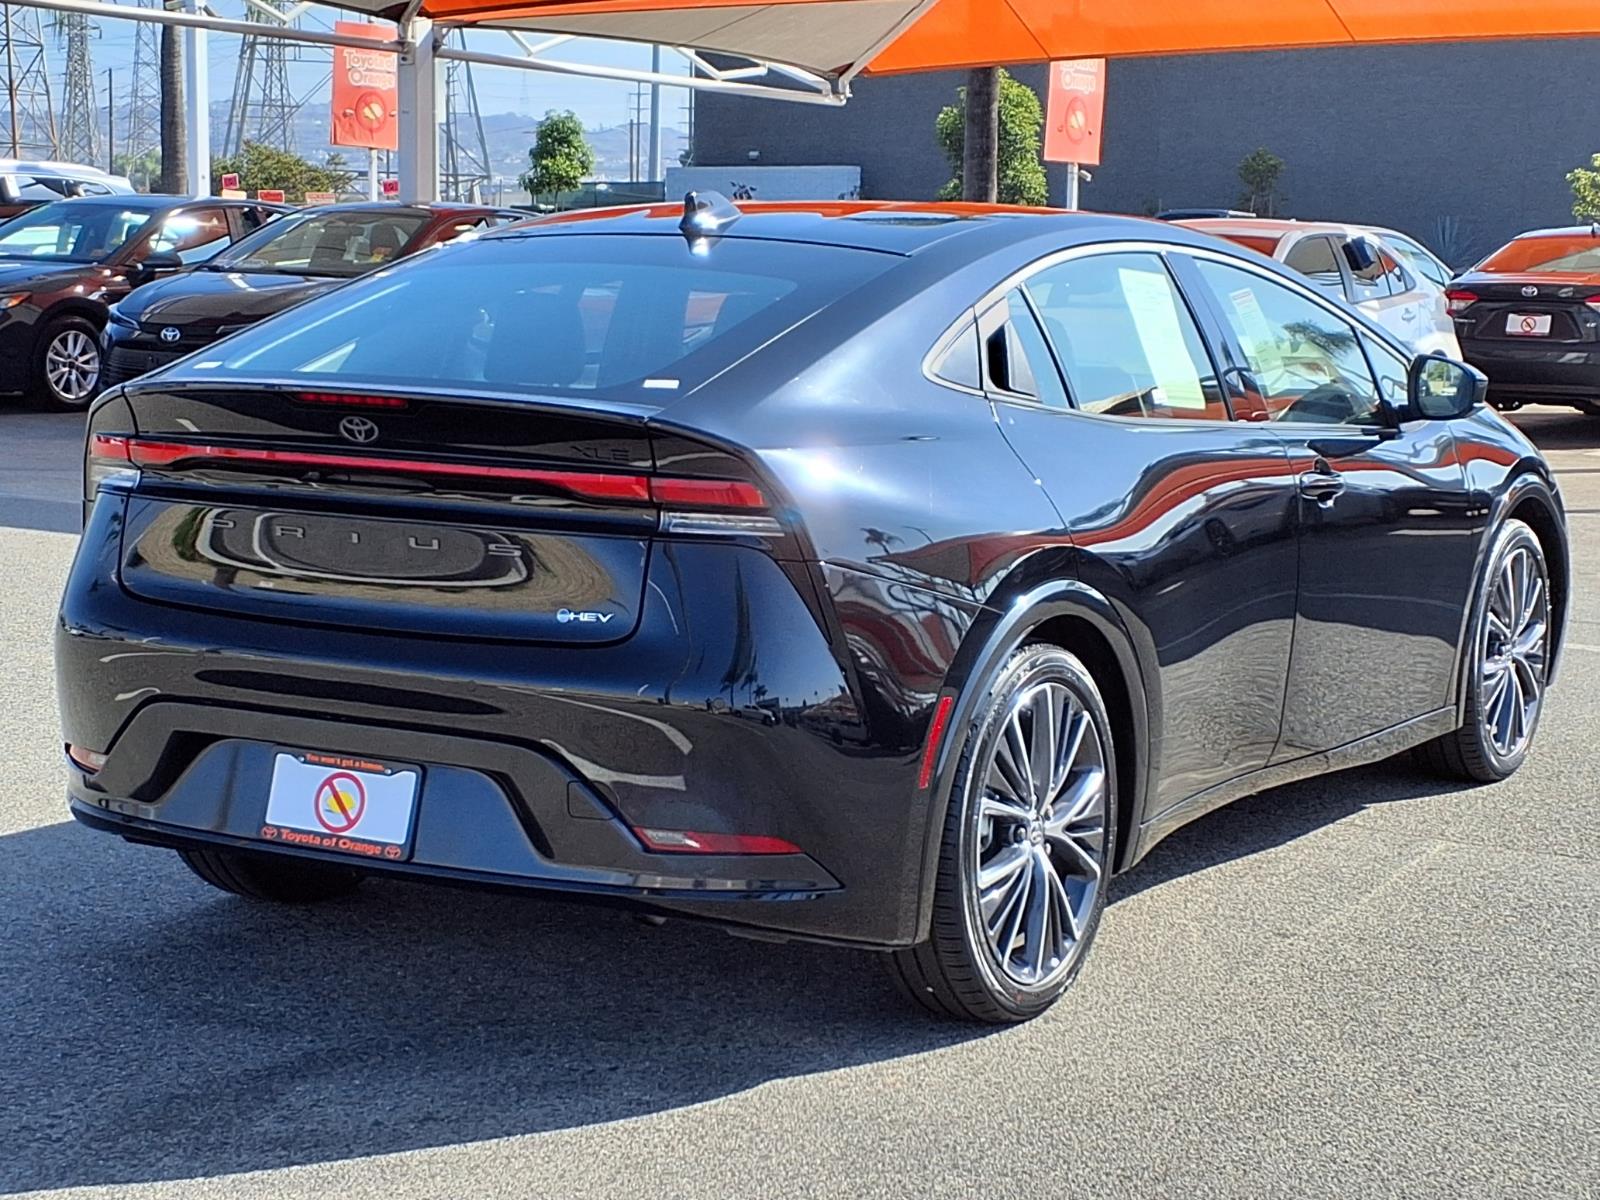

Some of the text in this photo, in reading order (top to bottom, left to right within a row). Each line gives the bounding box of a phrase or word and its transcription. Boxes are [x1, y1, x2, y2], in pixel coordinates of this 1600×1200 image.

[569, 445, 630, 461] XLE
[207, 517, 522, 558] PRIUS
[569, 611, 615, 624] HEV
[280, 828, 382, 856] Toyota of Orange
